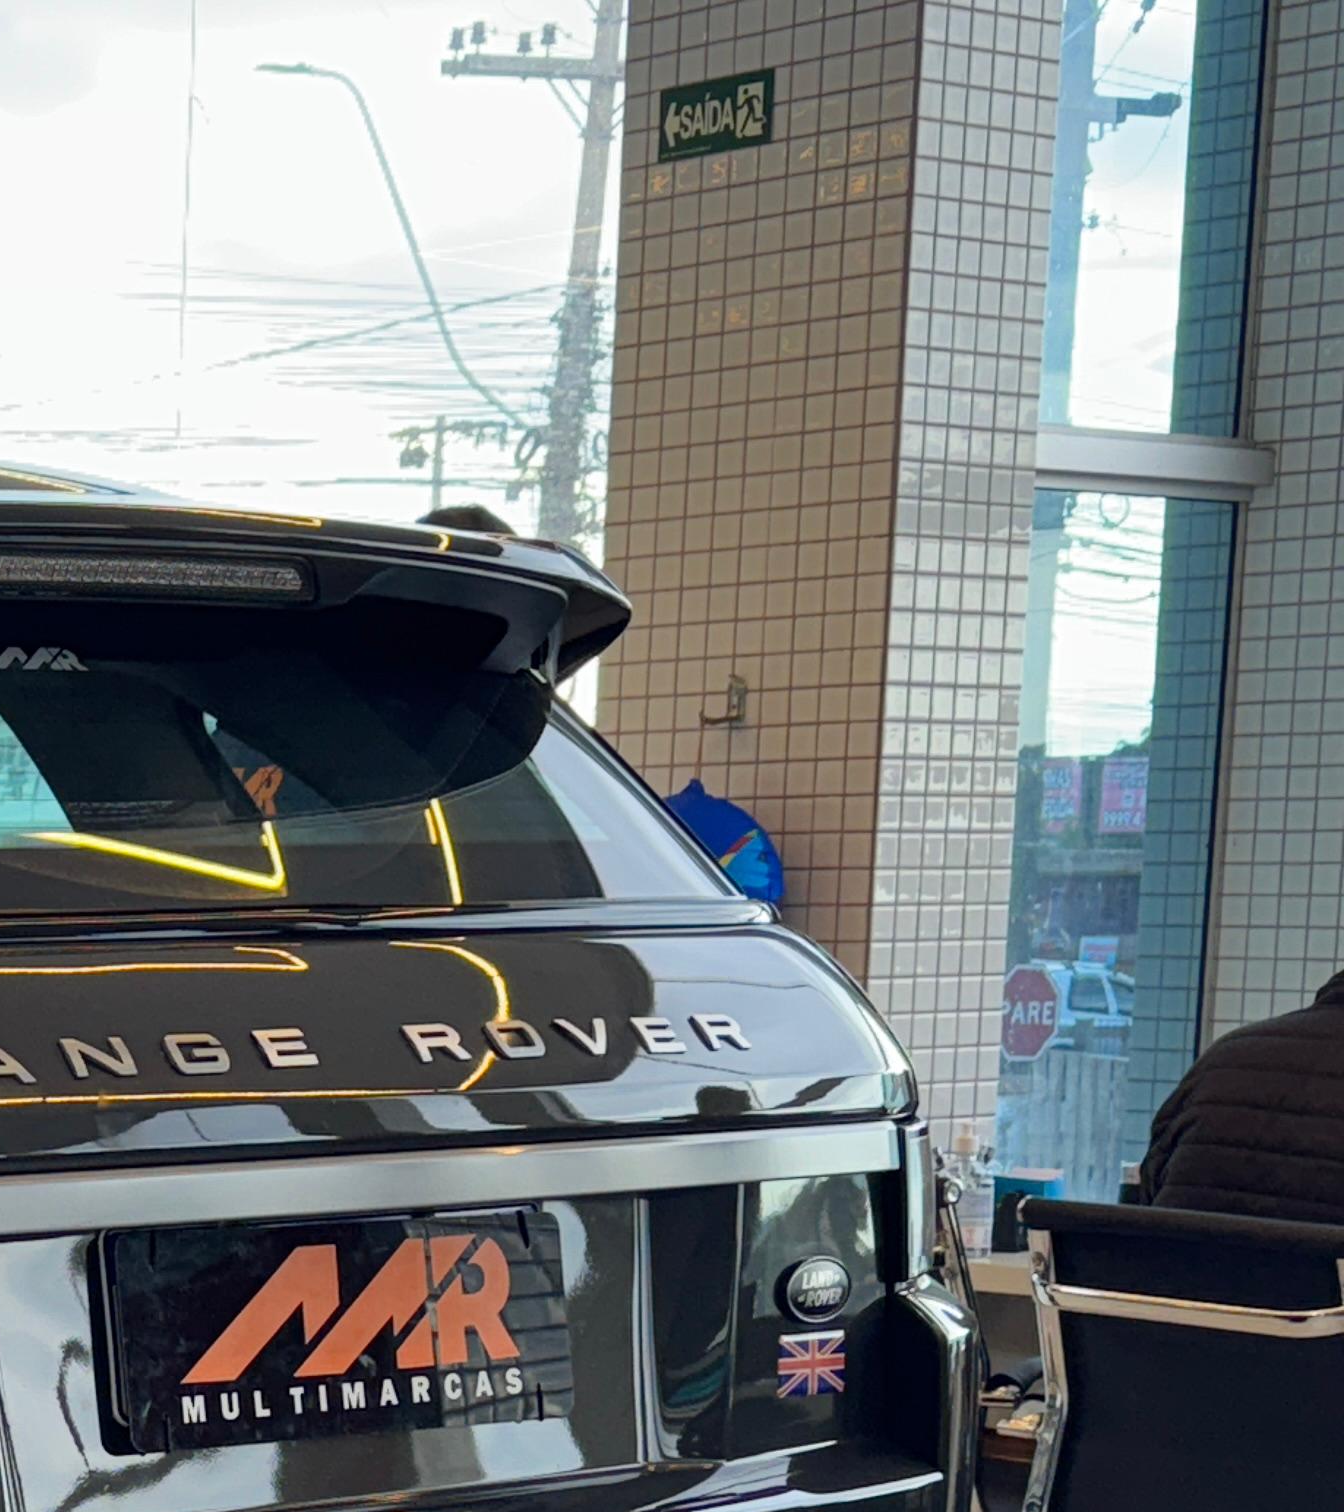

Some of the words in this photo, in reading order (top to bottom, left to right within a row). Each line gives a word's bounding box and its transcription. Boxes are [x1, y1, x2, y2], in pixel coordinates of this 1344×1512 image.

[680, 92, 734, 139] SAÍDA
[400, 1013, 752, 1063] ROVER
[802, 1270, 833, 1290] LAND
[180, 1366, 525, 1425] MULTIMARCAS
